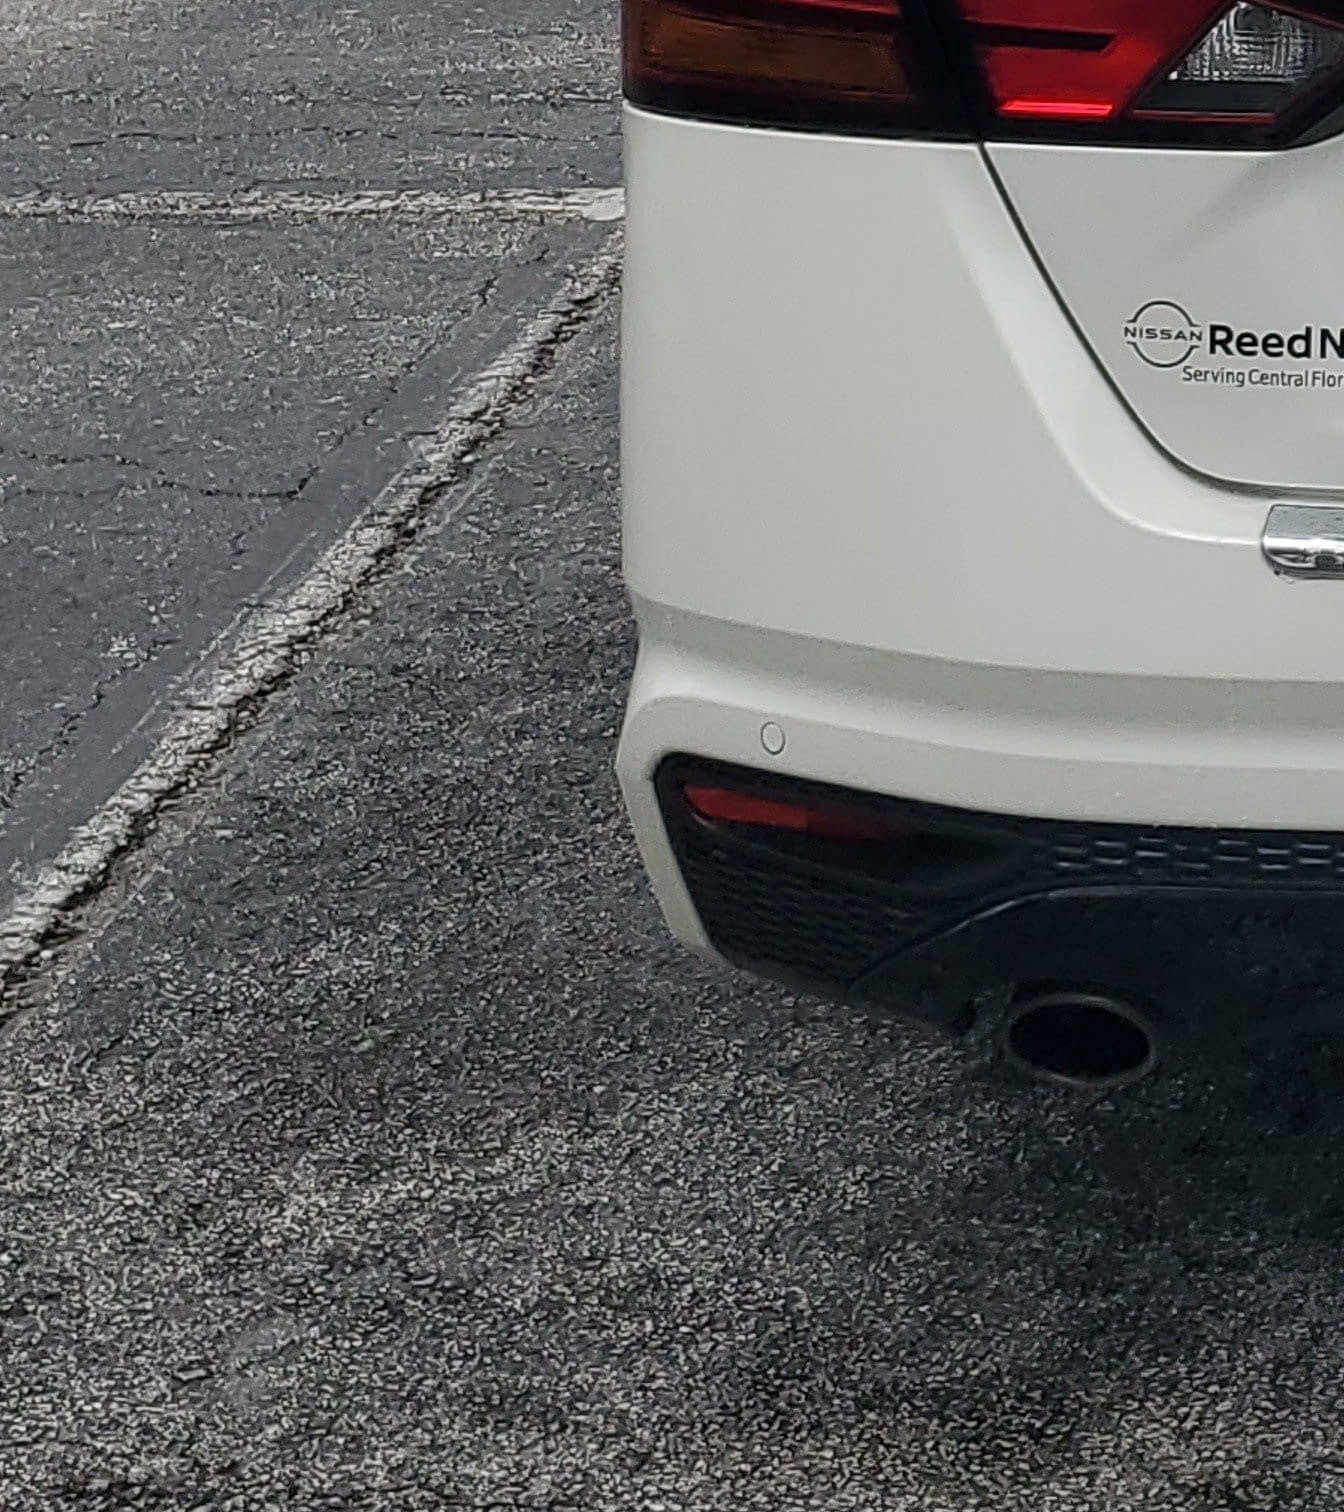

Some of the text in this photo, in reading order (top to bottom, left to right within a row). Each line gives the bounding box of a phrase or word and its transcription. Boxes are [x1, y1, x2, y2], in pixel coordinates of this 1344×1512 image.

[1123, 326, 1203, 342] NISSAN
[1208, 324, 1313, 359] Reed
[1182, 365, 1246, 388] Serving
[1248, 368, 1309, 388] Central
